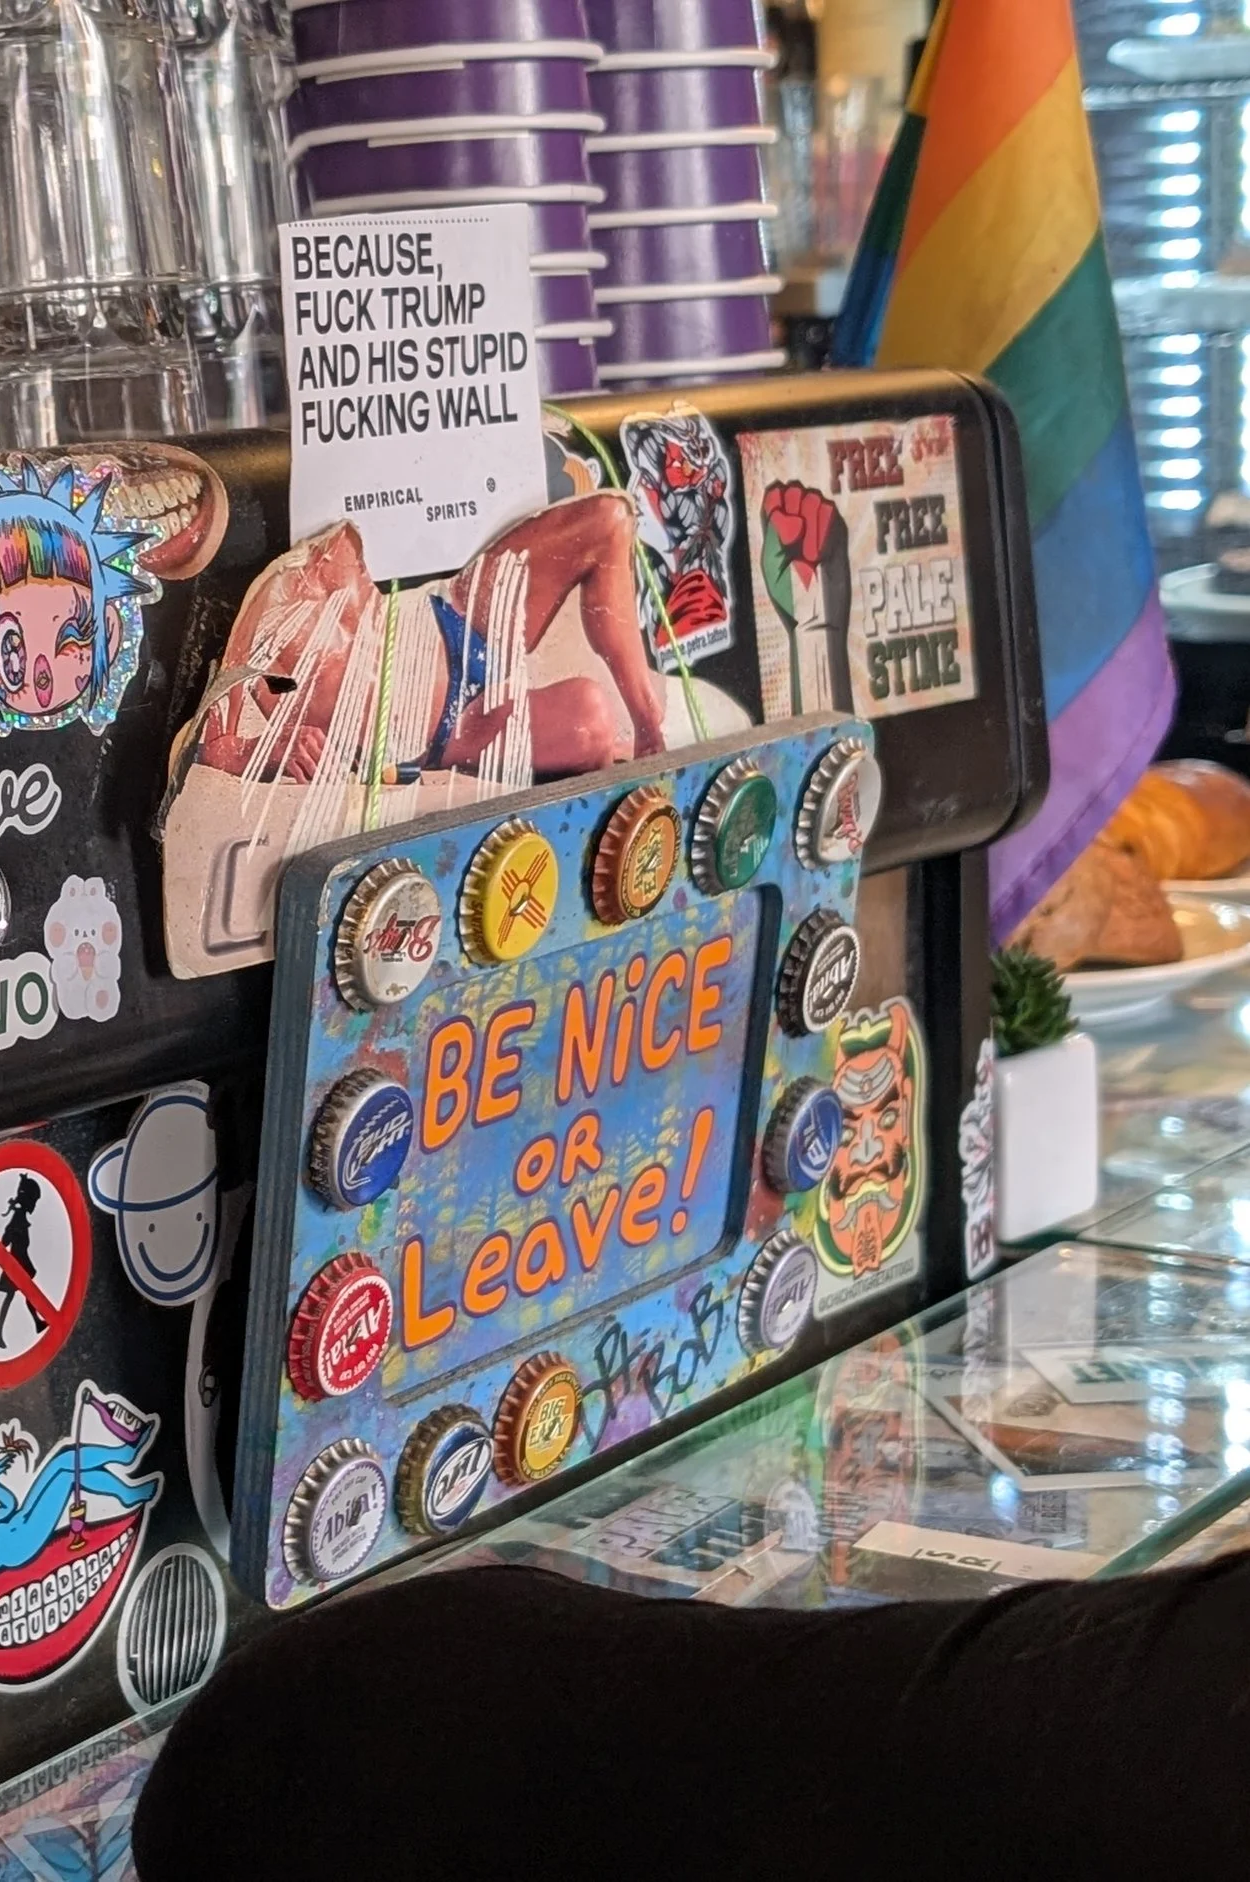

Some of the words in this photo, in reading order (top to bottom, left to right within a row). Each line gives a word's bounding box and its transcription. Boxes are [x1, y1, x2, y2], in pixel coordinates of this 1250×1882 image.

[292, 233, 443, 281] BECAUSE,
[295, 288, 376, 335] FUCK
[382, 283, 486, 330] TRUMP
[298, 344, 360, 391] AND
[368, 338, 419, 384] HIS
[426, 331, 528, 380] STUPID
[302, 391, 430, 445] FUCKING
[436, 383, 519, 430] WALL
[826, 435, 904, 494] FREE
[344, 487, 424, 513] EMPIRICAL
[426, 501, 478, 522] SPIRITS
[874, 494, 948, 554] FREE
[859, 559, 957, 638] PALE
[866, 628, 961, 700] STINE
[419, 1000, 536, 1154] BE
[514, 1108, 604, 1197] OR
[400, 1105, 715, 1353] Leave!
[538, 1396, 568, 1423] BIG
[319, 1484, 378, 1551] Abia!
